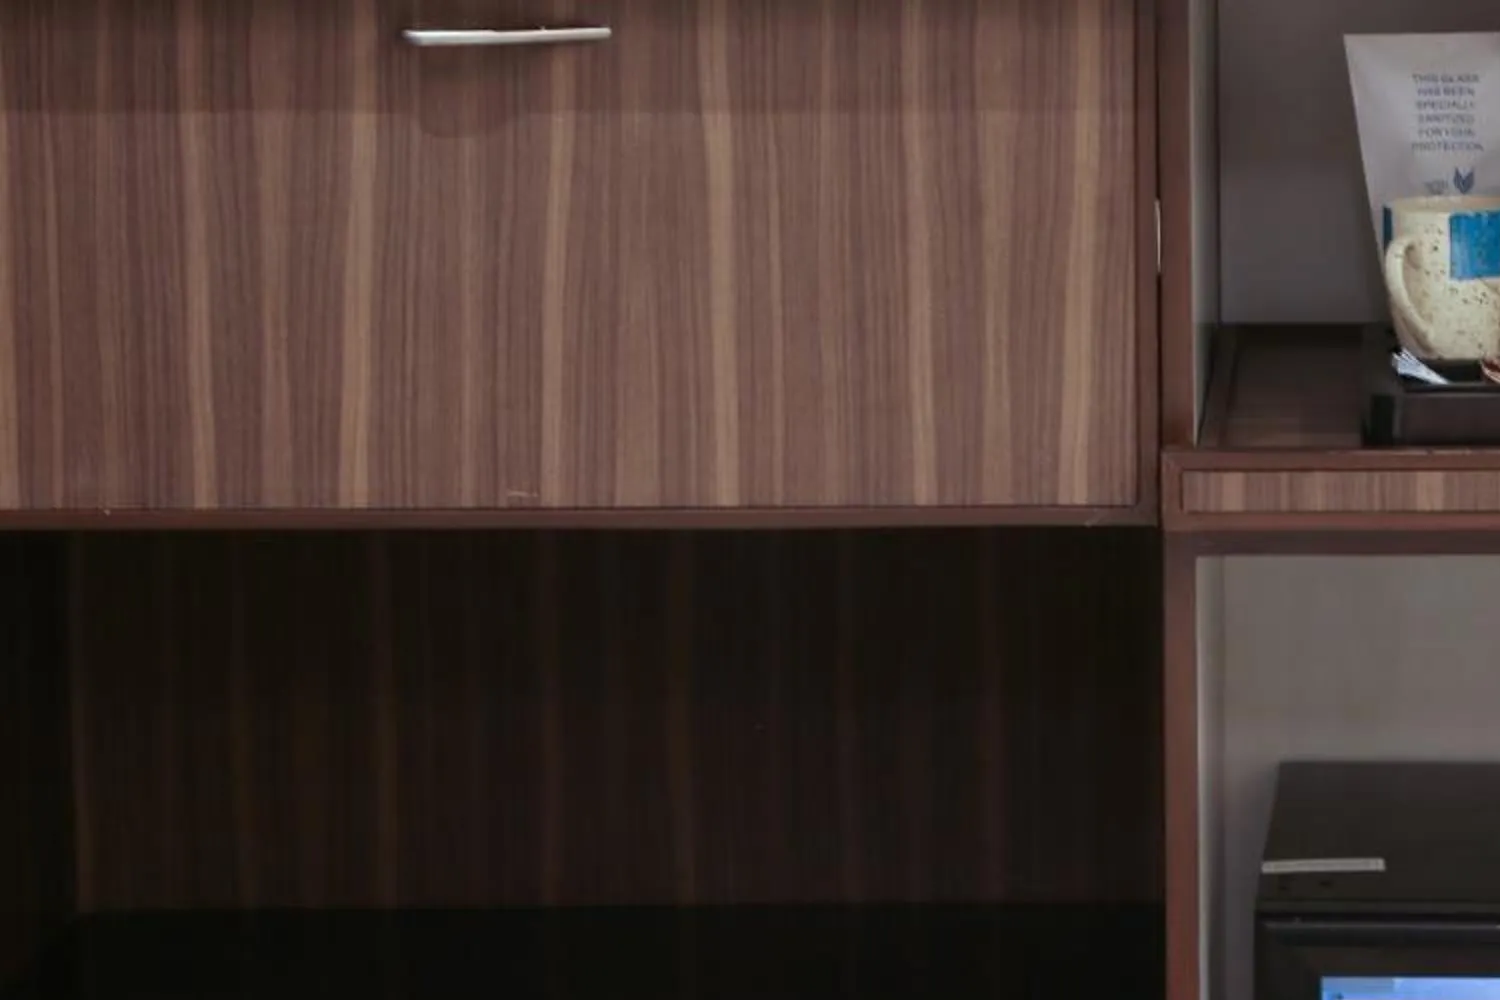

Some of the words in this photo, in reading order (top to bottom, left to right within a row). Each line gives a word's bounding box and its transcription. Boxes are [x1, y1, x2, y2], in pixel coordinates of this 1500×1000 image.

[1412, 73, 1439, 83] THIS
[1441, 73, 1480, 83] GLASS
[1417, 87, 1441, 96] HAS
[1443, 86, 1475, 97] BEEN
[1416, 99, 1475, 110] SPECIALLY
[1418, 127, 1442, 138] FOR
[1444, 127, 1475, 138] YOUR
[1411, 142, 1484, 152] PROTECTION
